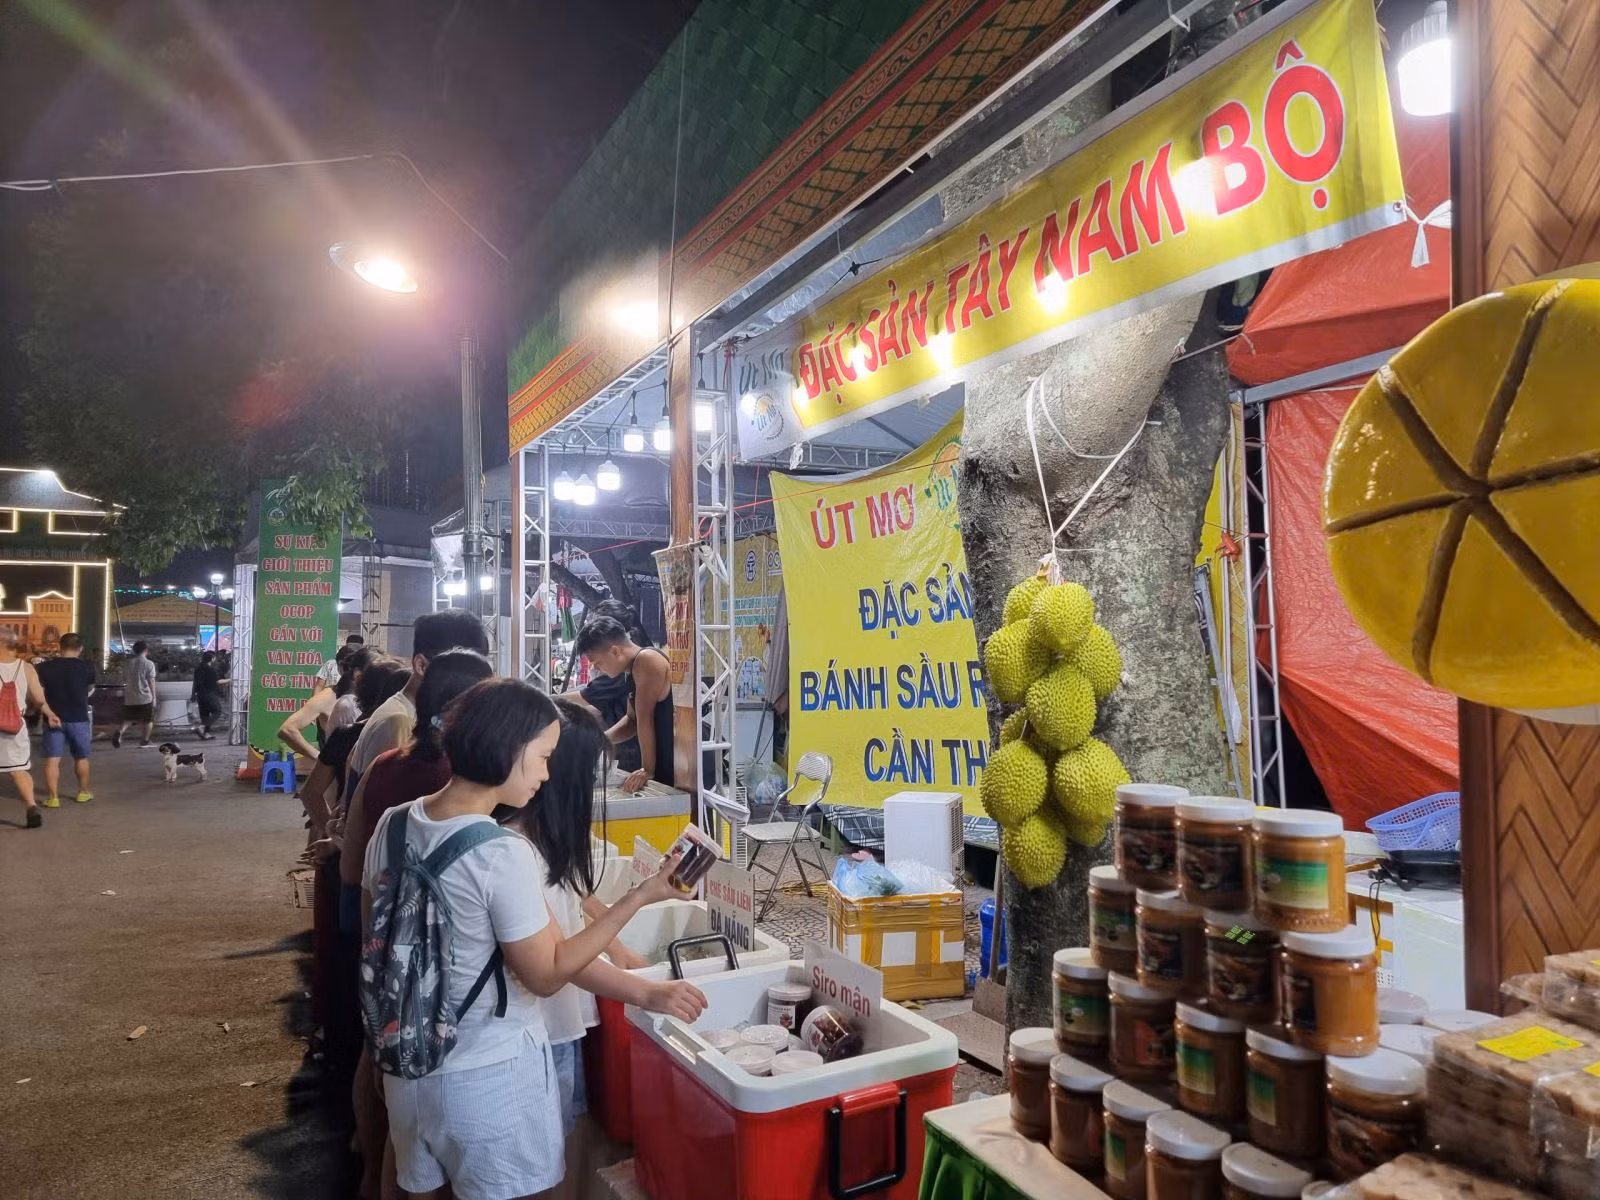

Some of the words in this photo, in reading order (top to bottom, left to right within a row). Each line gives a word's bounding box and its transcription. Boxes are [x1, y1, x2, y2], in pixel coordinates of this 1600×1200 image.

[799, 321, 857, 404] ĐẶC
[858, 279, 935, 372] SẢN
[944, 232, 1030, 335] TÂY
[1033, 142, 1186, 294] NAM
[1202, 40, 1345, 216] BỘ
[810, 498, 857, 550] ÚT
[865, 483, 915, 539] MƠ
[280, 604, 315, 618] OCOP
[858, 579, 921, 640] ĐẶC
[261, 672, 286, 689] CÁC
[266, 698, 296, 712] NAM
[800, 658, 889, 711] BÁNH
[896, 651, 962, 710] SẦU
[864, 727, 936, 785] CẦN
[941, 739, 988, 787] TH
[812, 965, 837, 998] Siro
[840, 985, 871, 1017] mận
